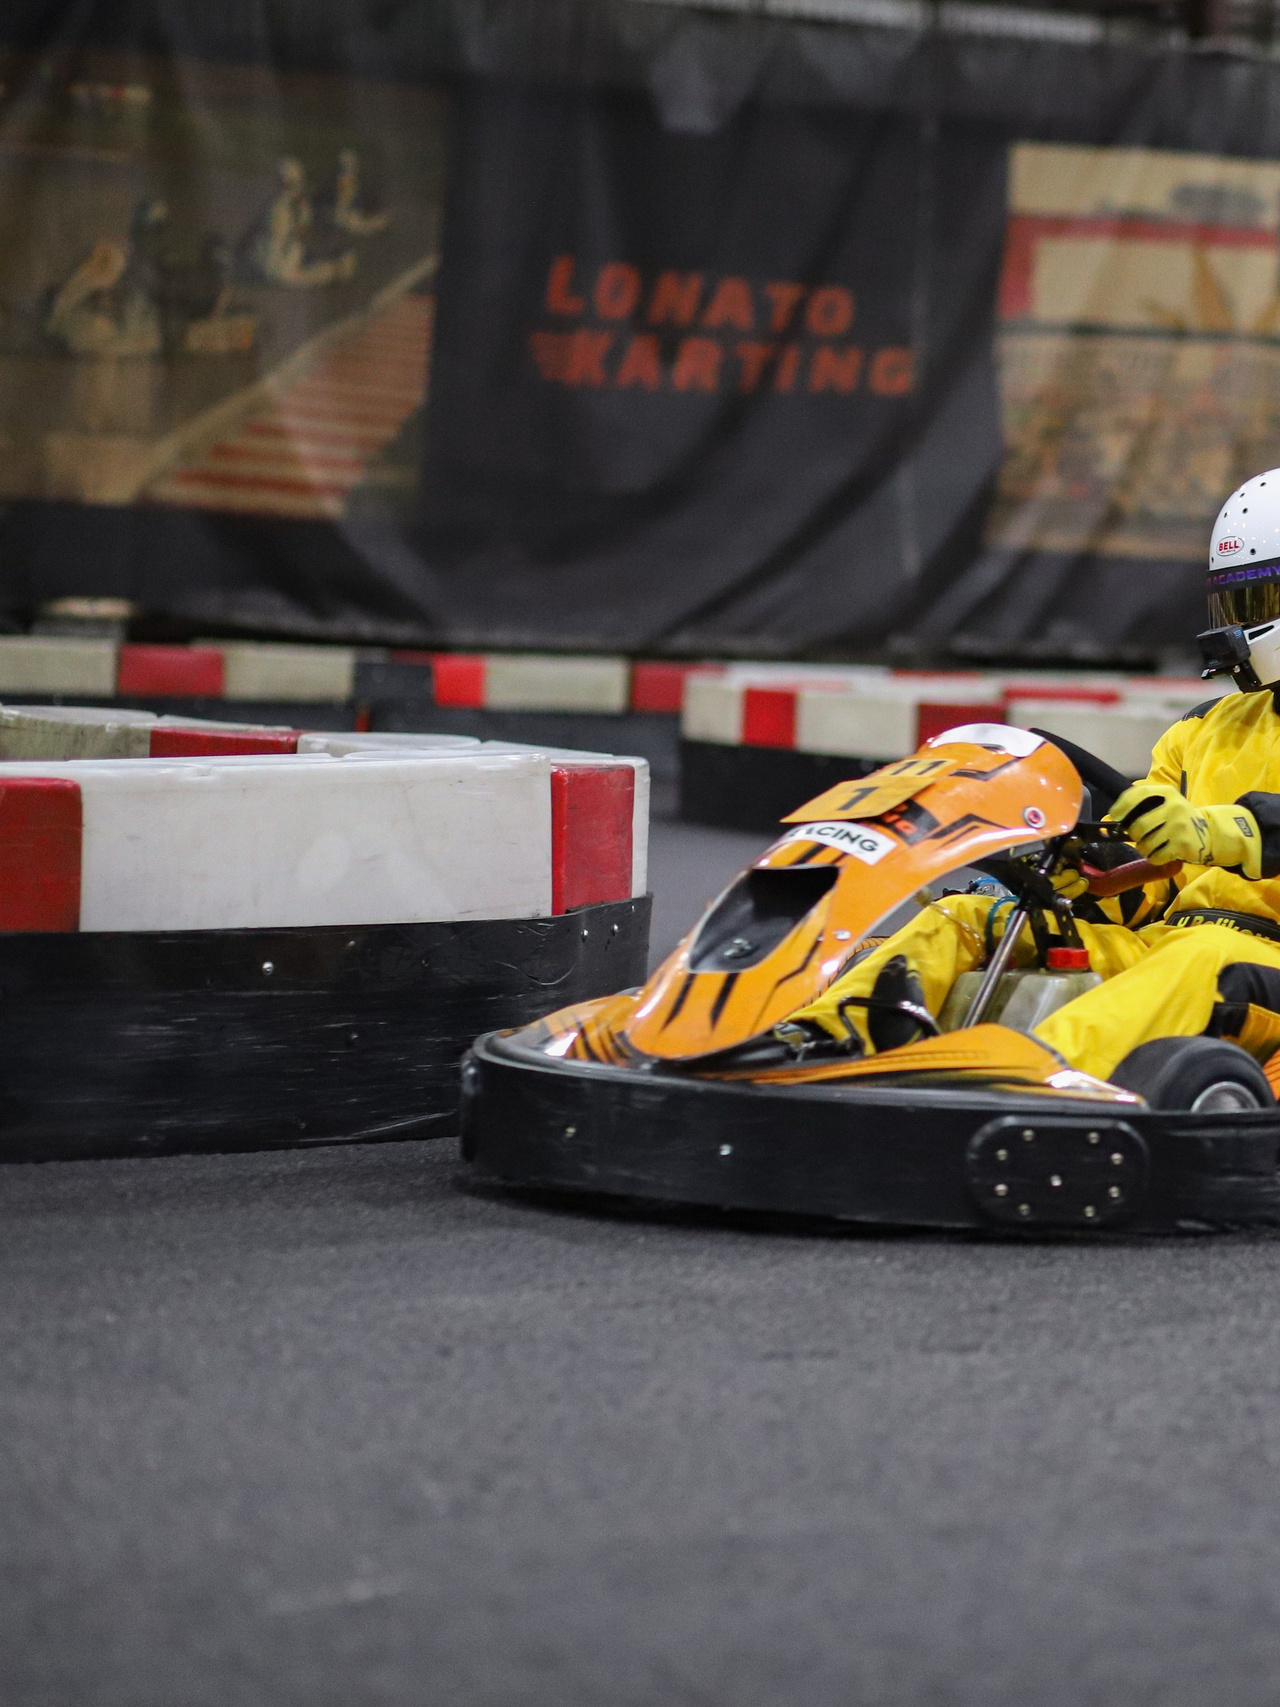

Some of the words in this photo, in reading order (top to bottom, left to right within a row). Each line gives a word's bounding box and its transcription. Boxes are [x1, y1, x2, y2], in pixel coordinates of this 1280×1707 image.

[547, 254, 855, 336] LONATO
[558, 329, 915, 395] KARTING
[1218, 540, 1240, 552] BELL
[836, 786, 880, 812] 1
[790, 826, 879, 852] ACING
